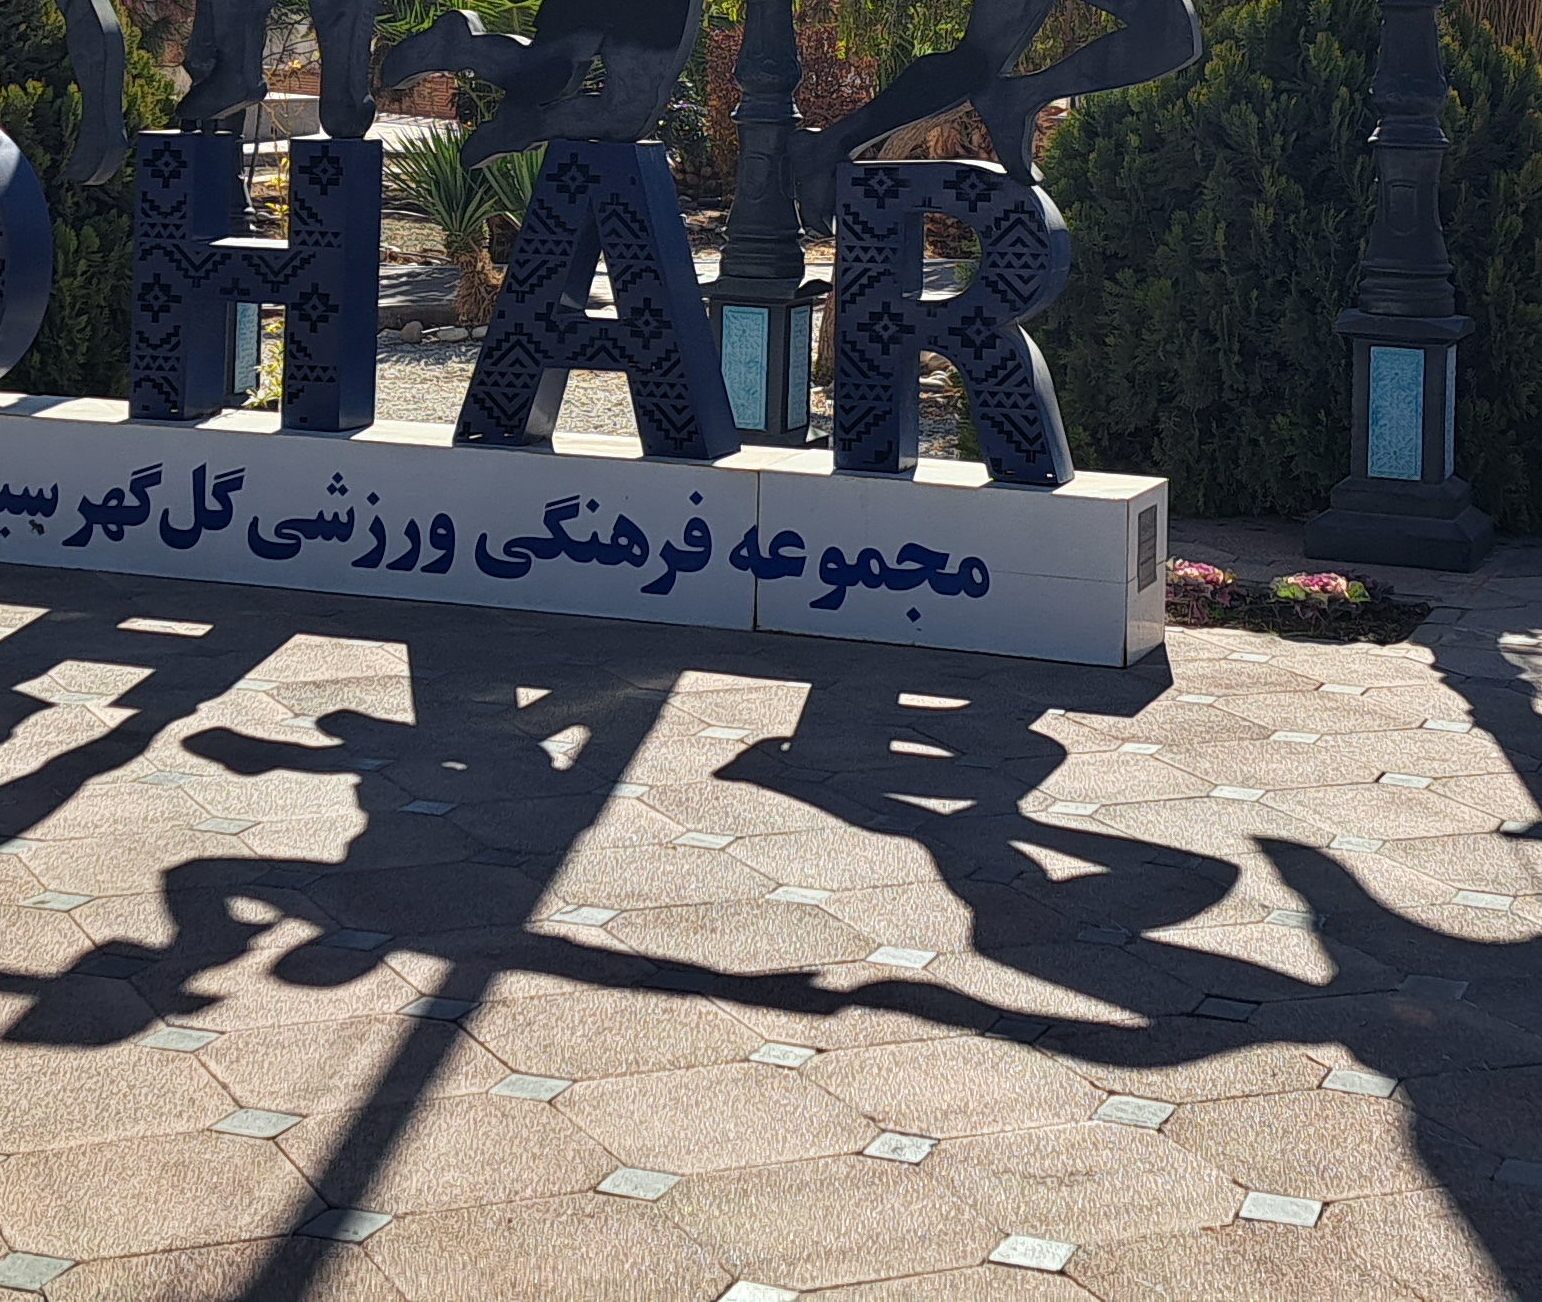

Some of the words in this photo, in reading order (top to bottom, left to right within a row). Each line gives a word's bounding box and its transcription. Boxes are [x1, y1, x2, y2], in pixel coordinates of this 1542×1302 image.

[247, 471, 457, 575] ورزشی
[474, 490, 713, 596] فرهنگی
[727, 524, 991, 623] مجموعه
